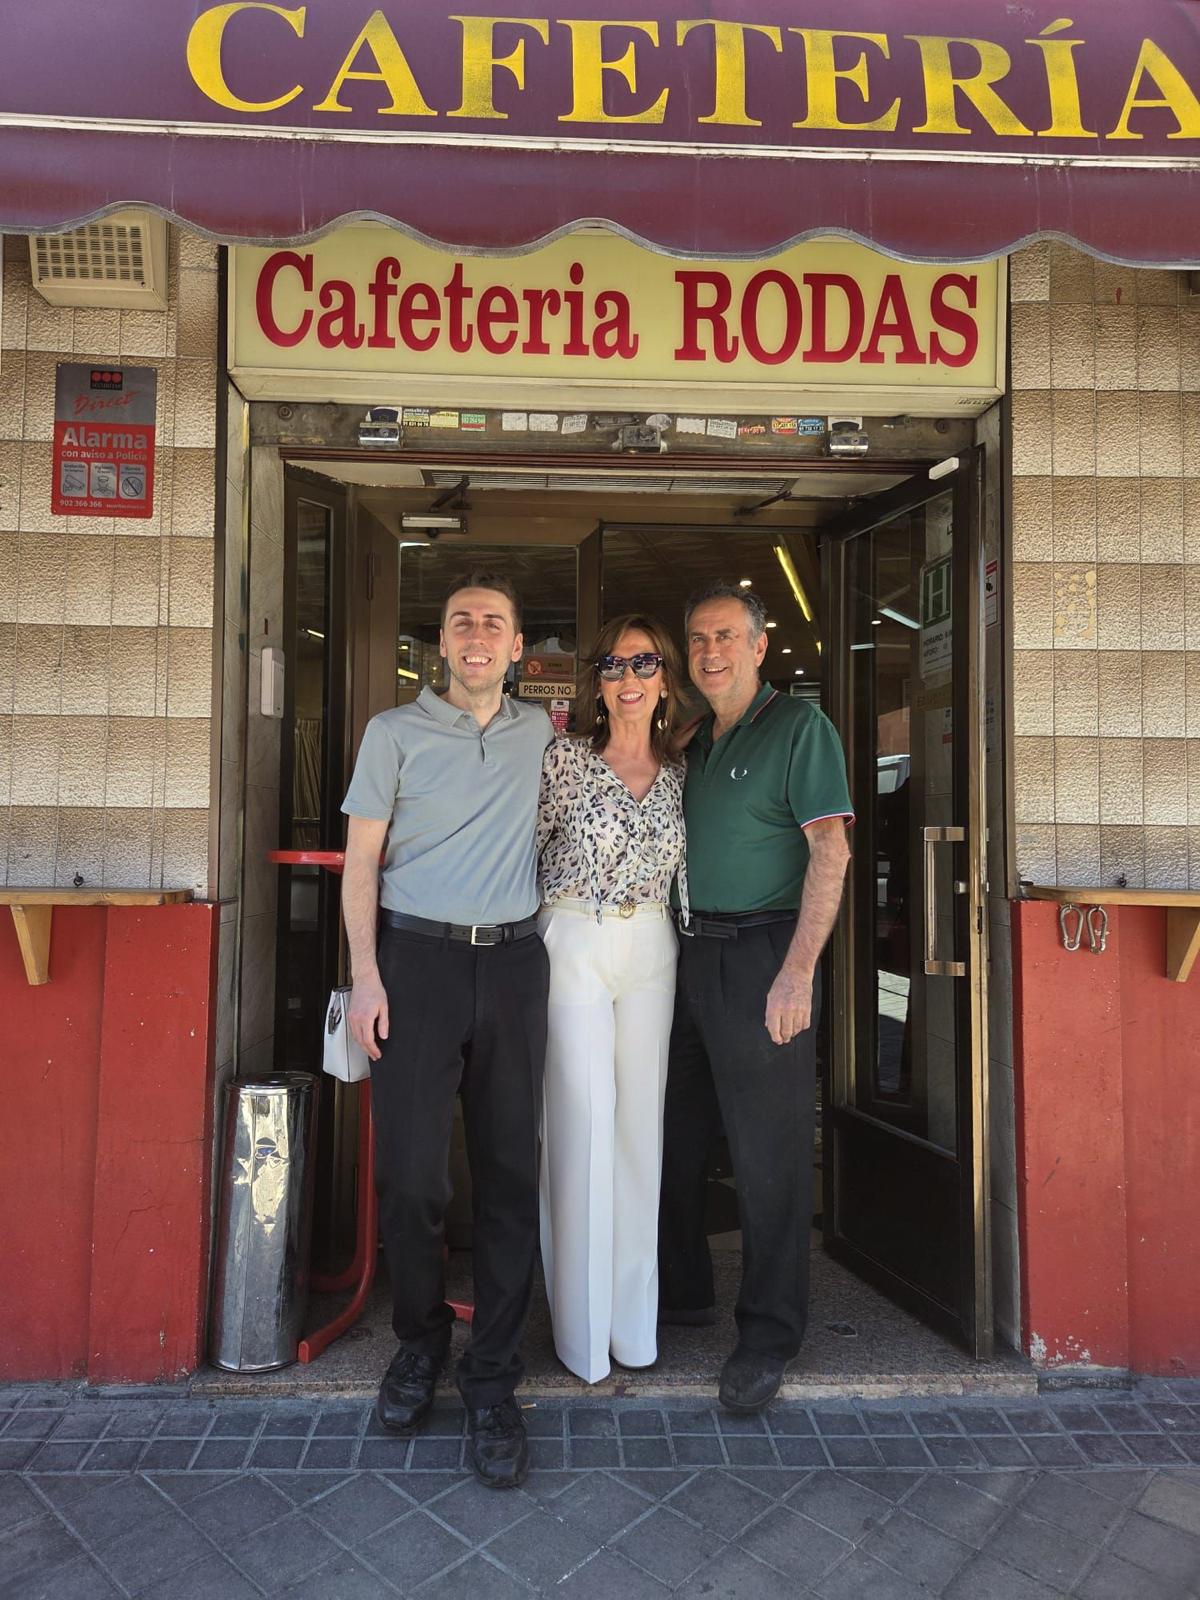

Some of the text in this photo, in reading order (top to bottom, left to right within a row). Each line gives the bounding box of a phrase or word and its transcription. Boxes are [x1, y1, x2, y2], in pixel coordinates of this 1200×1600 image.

[186, 1, 1200, 140] CAFETERÍA
[256, 251, 978, 367] Cafeteria RODAS
[62, 427, 148, 449] Alarma
[61, 450, 78, 458] con
[80, 449, 106, 459] aviso
[59, 499, 73, 507] 902
[926, 562, 950, 623] H
[523, 685, 572, 695] PERROS NO
